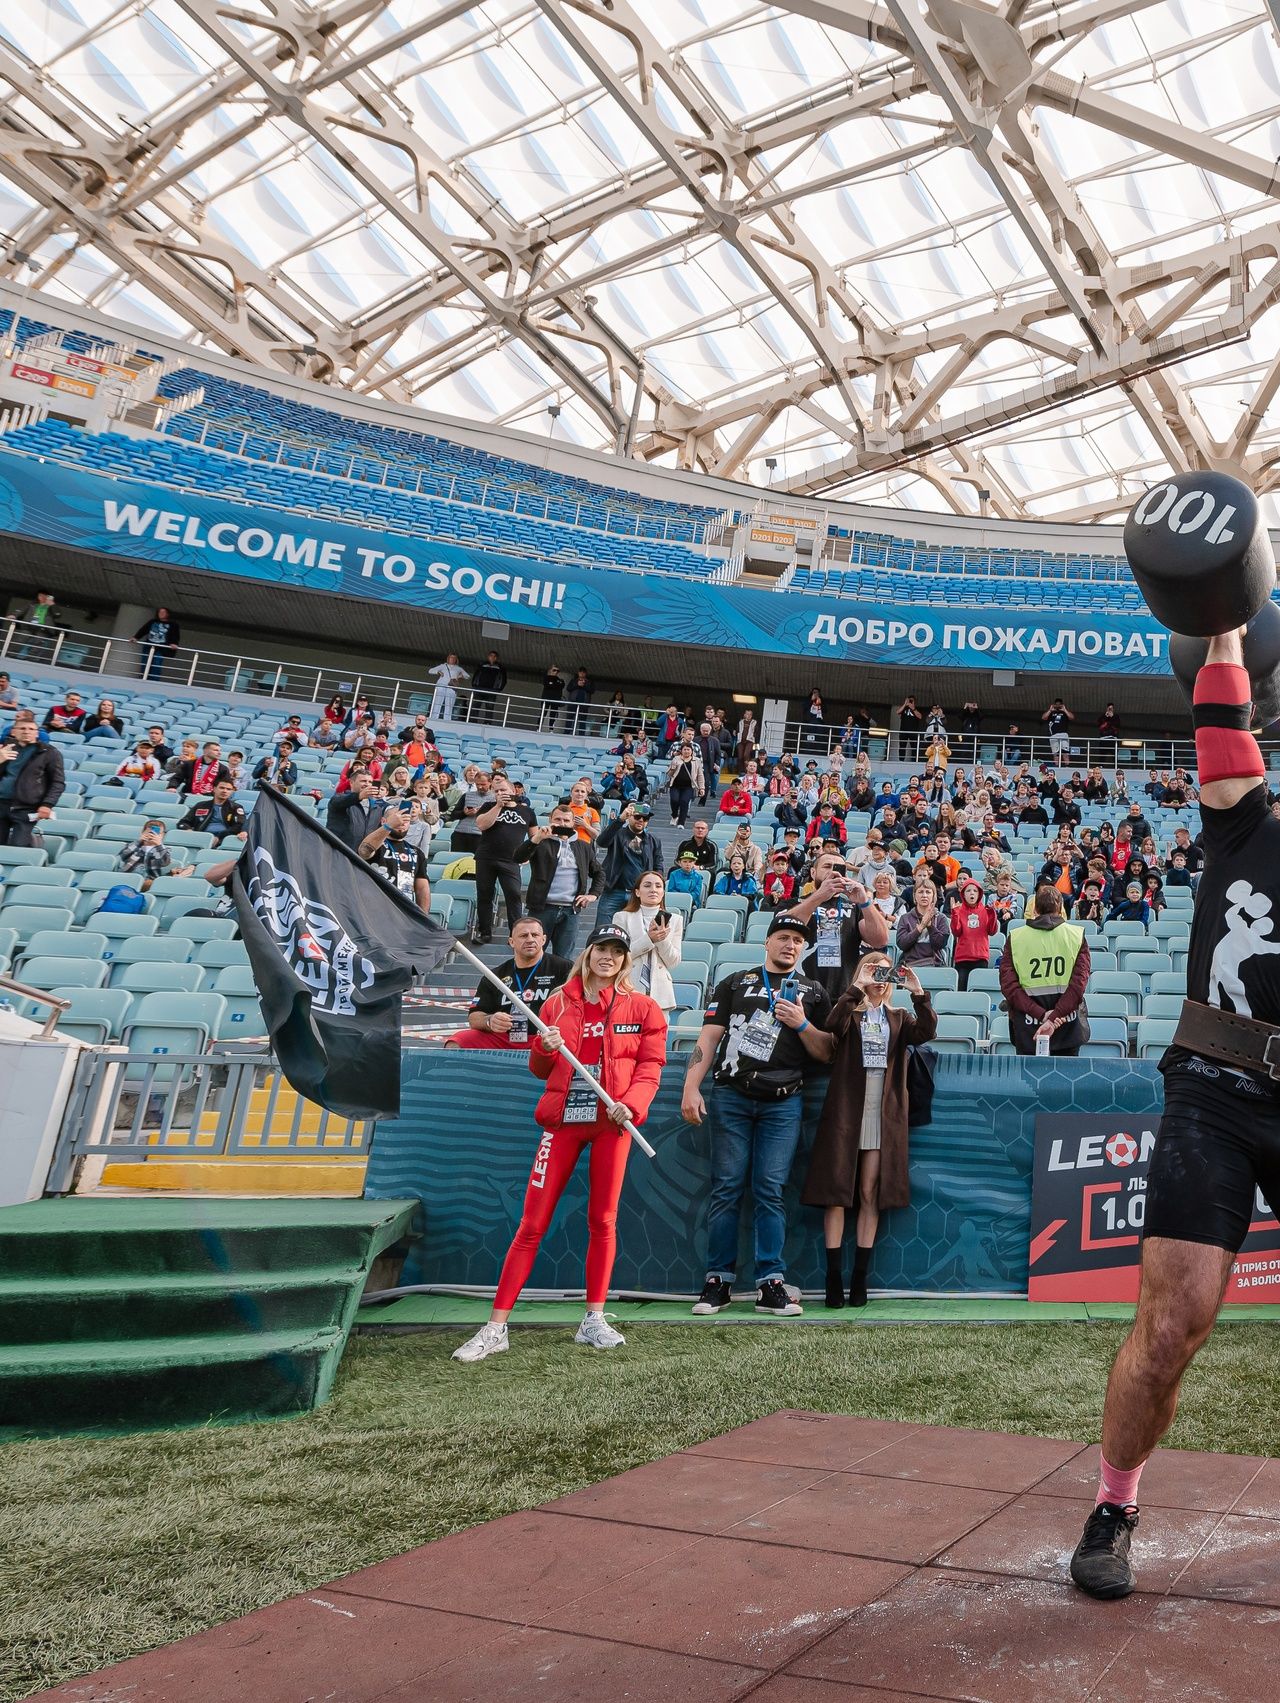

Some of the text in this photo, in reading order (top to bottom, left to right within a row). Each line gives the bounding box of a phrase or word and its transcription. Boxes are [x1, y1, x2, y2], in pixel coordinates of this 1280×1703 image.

[1134, 484, 1237, 544] 100
[103, 500, 566, 610] WELCOME TO SOCHI!
[807, 614, 933, 649] ДОБРО
[943, 623, 1170, 659] ПОЖАЛОВАТ
[598, 927, 628, 939] LEON
[1029, 956, 1066, 979] 270
[616, 1024, 640, 1033] LEON
[531, 1131, 554, 1189] LEON
[1242, 1262, 1267, 1273] ПРИЗ
[1269, 1260, 1280, 1270] ОТ
[1237, 1278, 1250, 1288] ЗА
[1251, 1275, 1280, 1286] ВОЛЮ
